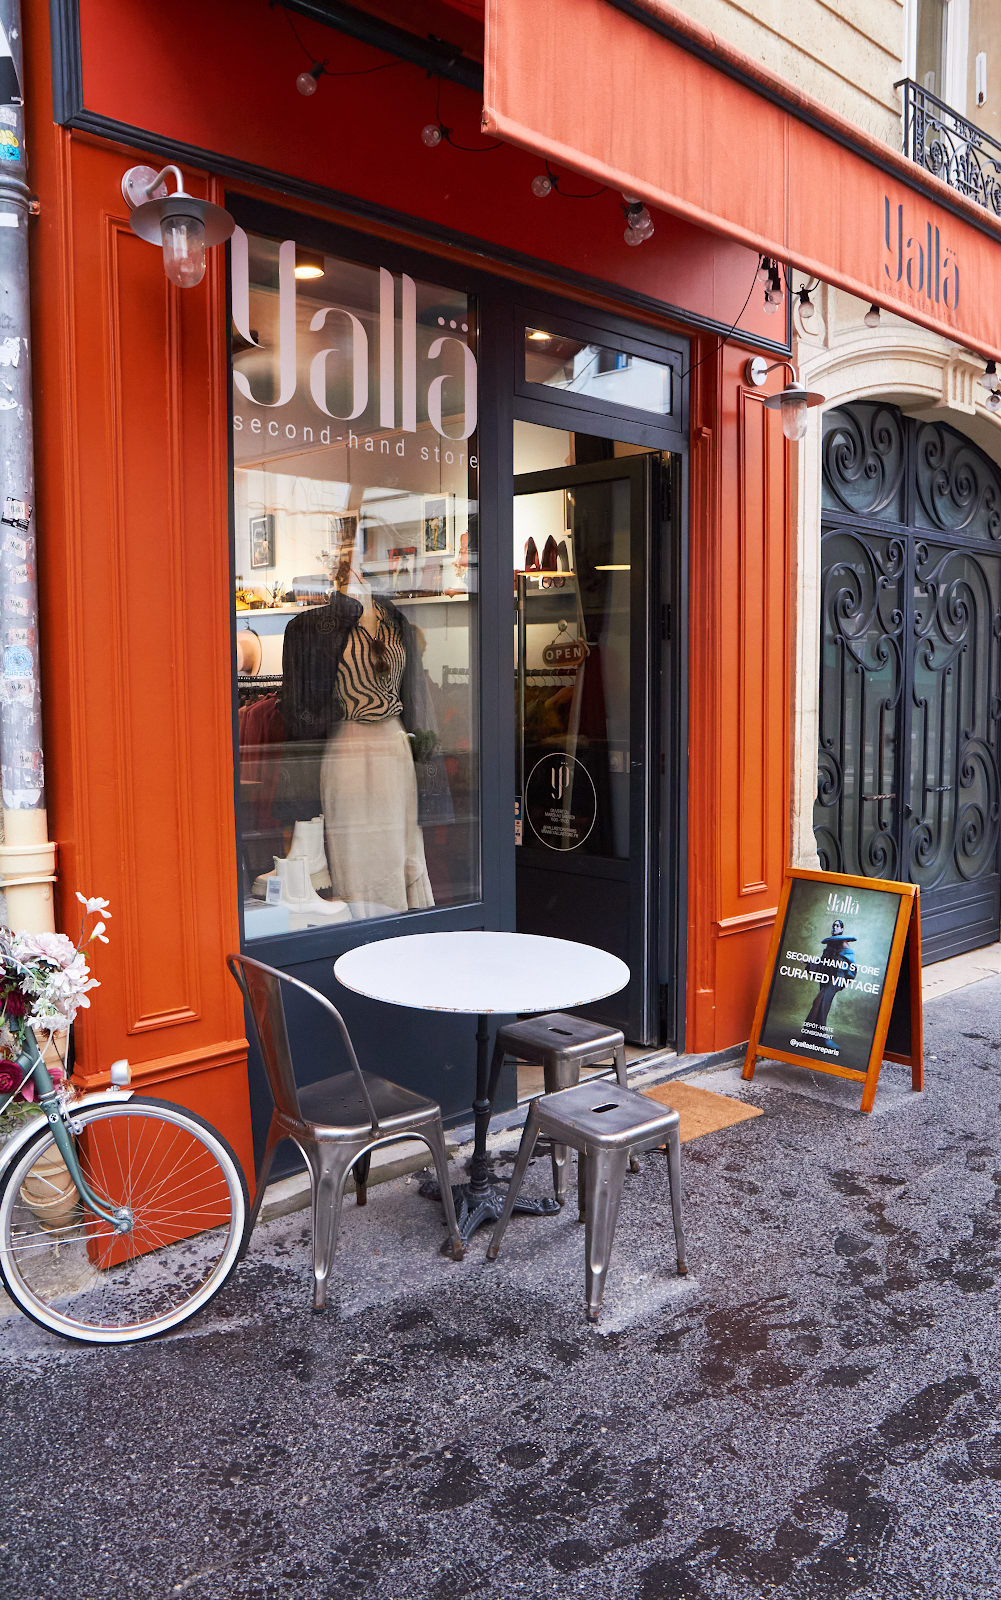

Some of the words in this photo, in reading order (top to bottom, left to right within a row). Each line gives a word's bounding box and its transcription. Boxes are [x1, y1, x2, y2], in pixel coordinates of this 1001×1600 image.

[233, 415, 406, 457] second-hand
[420, 446, 479, 469] store
[545, 648, 582, 660] OPEN
[785, 950, 849, 971] SECOND-HAND
[849, 963, 880, 977] STORE
[779, 965, 830, 984] CURATED
[831, 975, 881, 995] VINTAGE
[790, 1038, 840, 1057] @yallastoreparis
